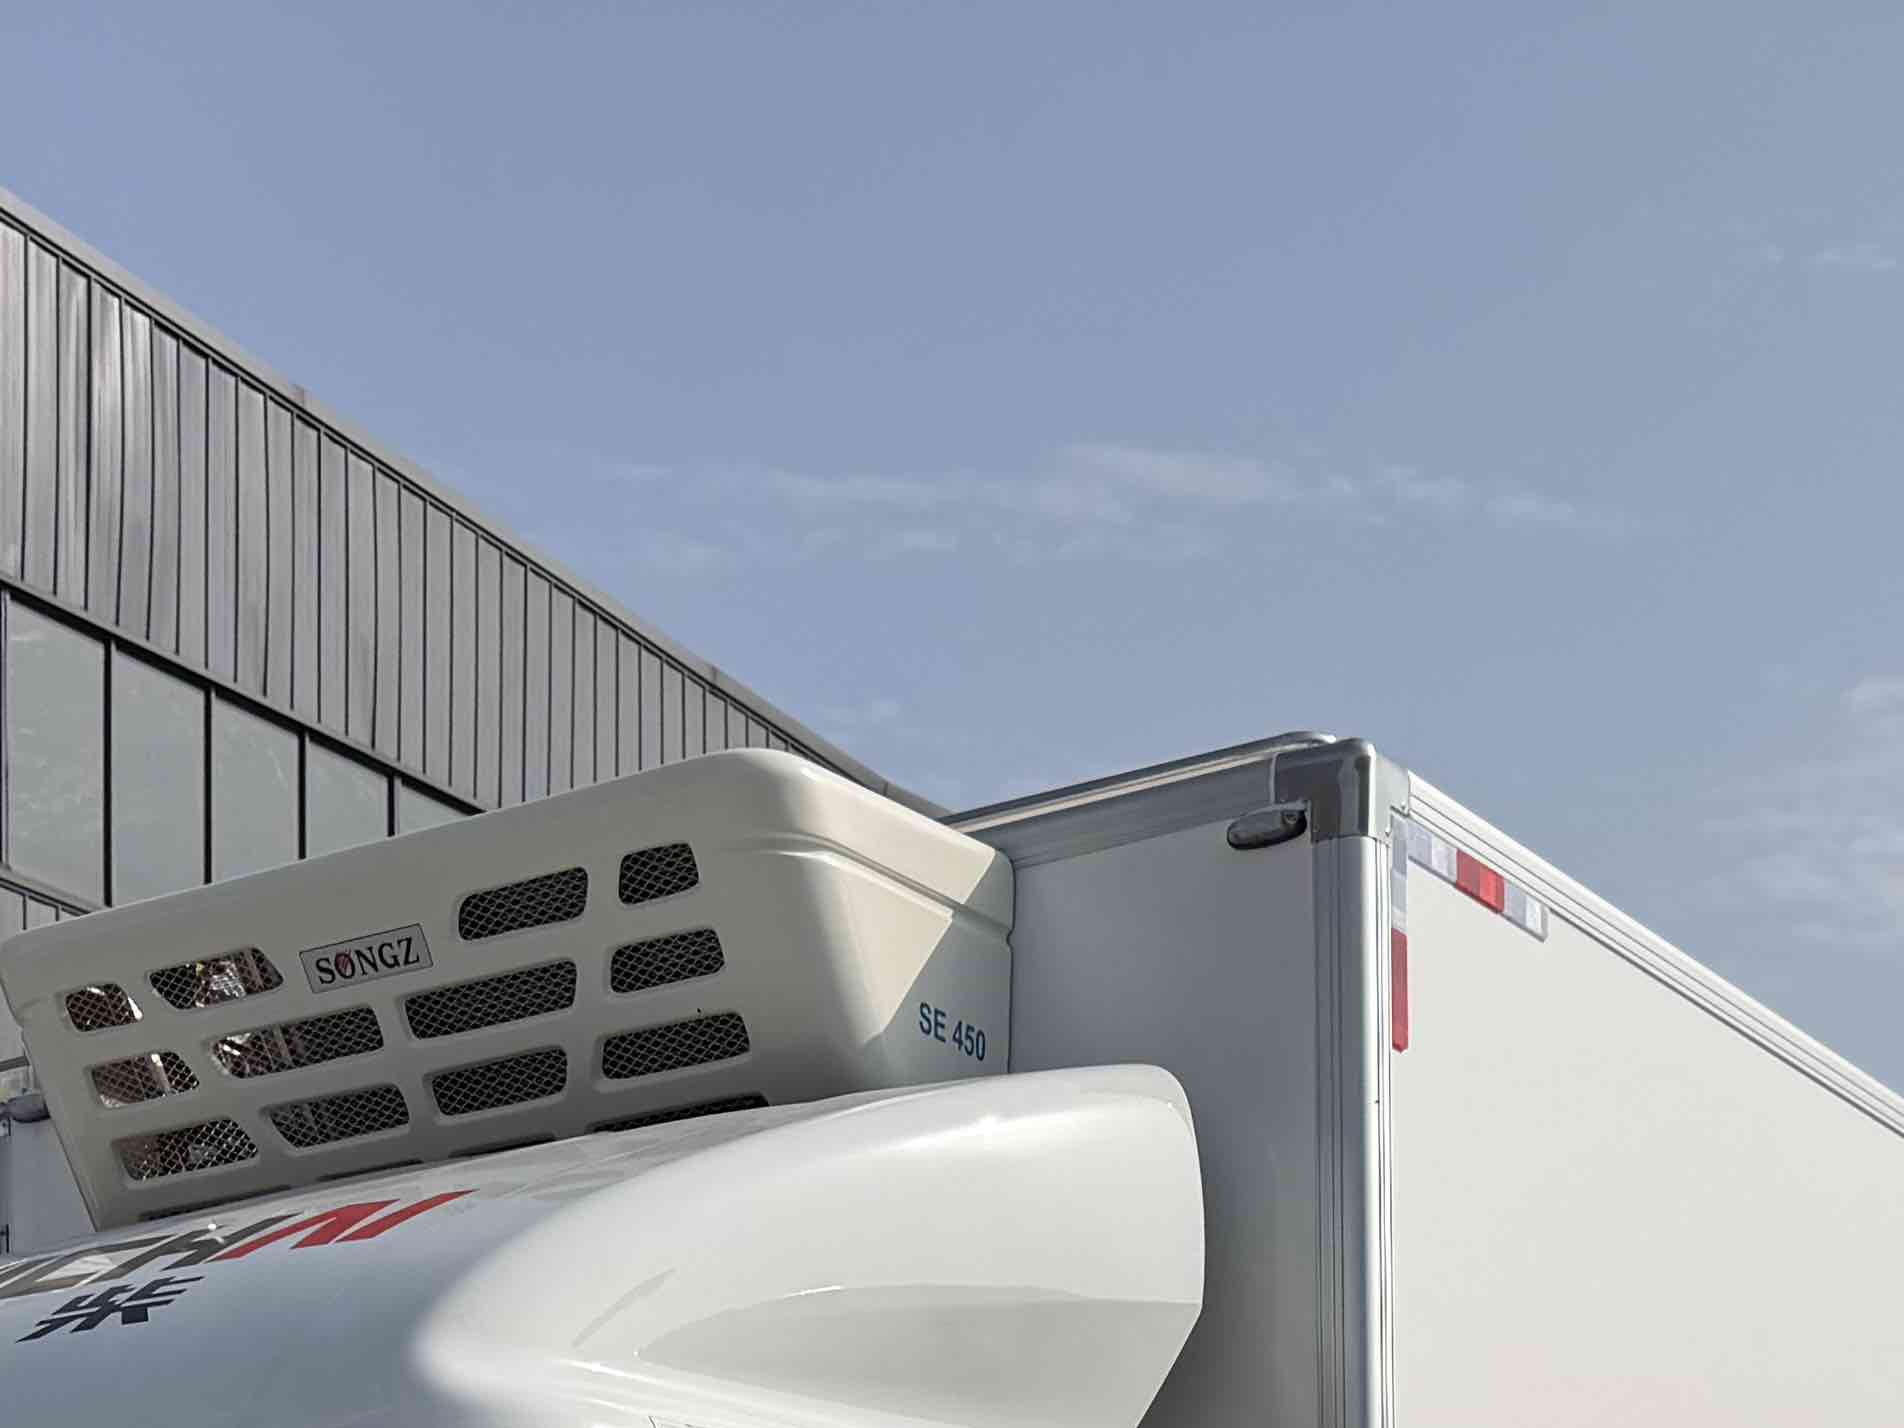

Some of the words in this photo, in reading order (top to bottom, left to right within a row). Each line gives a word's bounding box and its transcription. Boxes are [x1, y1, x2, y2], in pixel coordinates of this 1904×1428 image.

[314, 936, 421, 985] SONGZ
[919, 1001, 947, 1044] SE
[951, 1019, 986, 1062] 450
